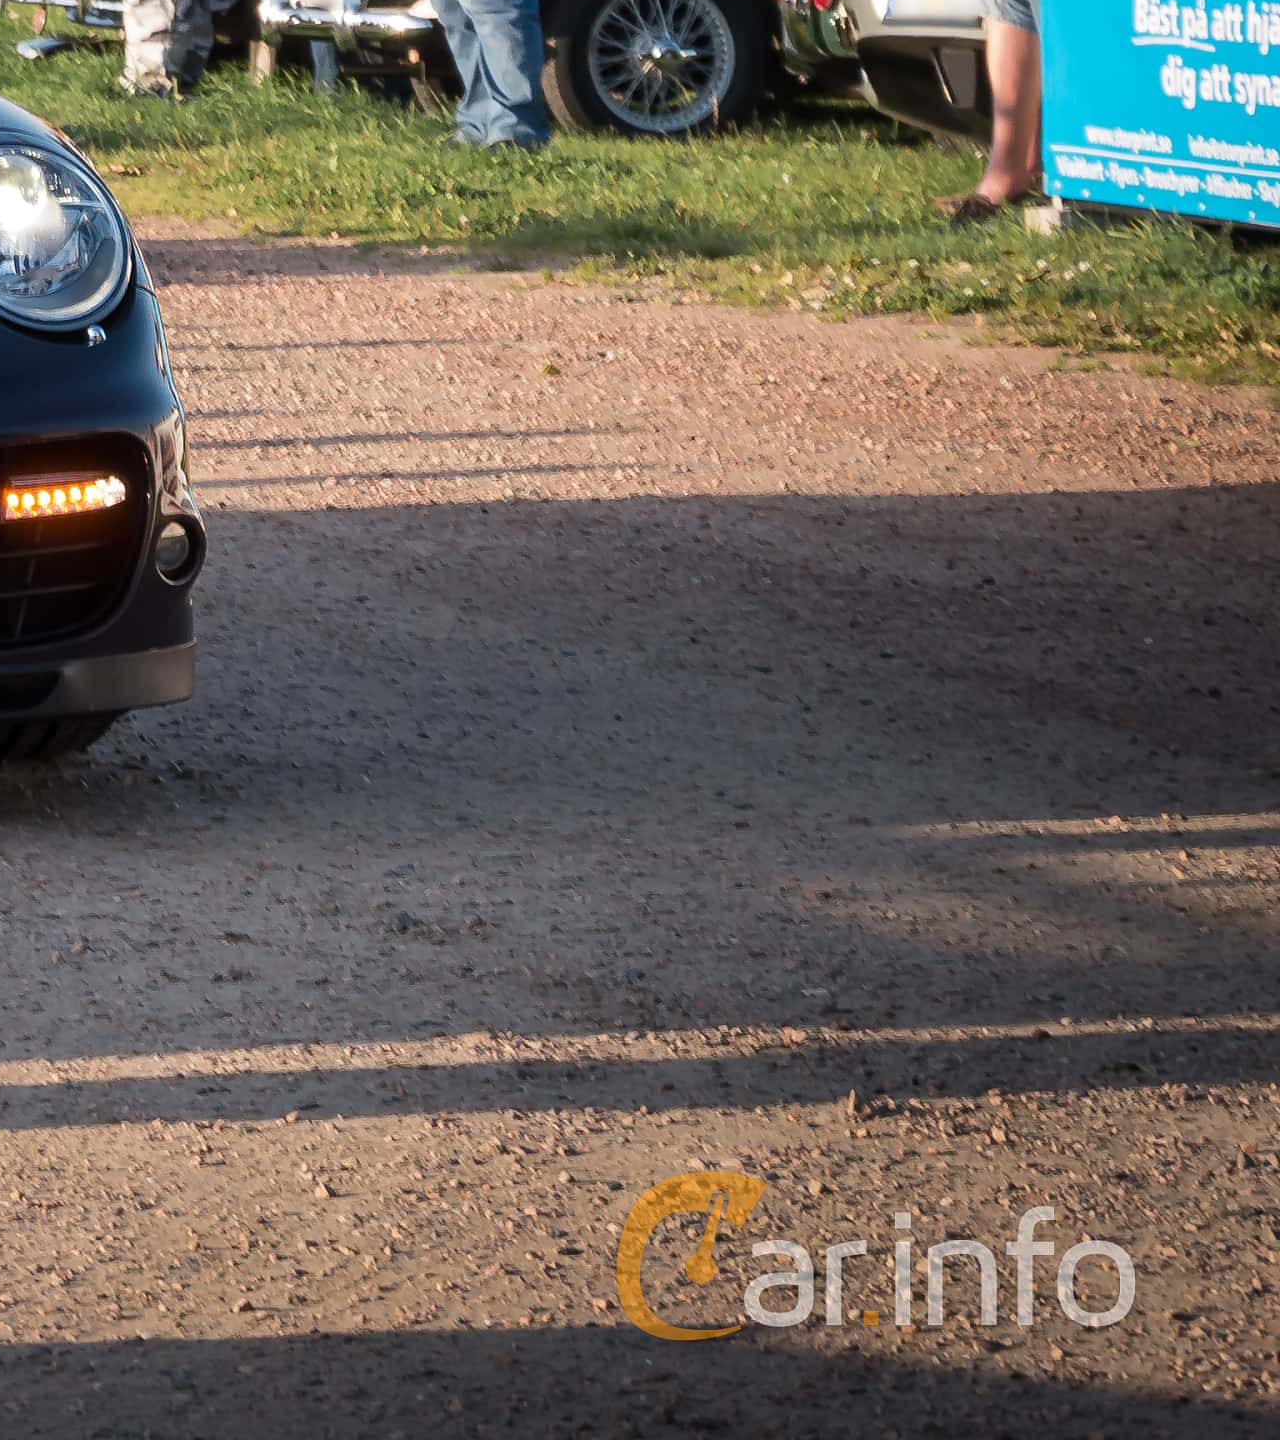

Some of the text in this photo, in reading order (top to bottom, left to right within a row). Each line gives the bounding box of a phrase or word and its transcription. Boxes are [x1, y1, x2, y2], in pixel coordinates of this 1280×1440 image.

[1211, 3, 1244, 43] att
[1160, 53, 1197, 109] dig
[1199, 64, 1233, 103] att
